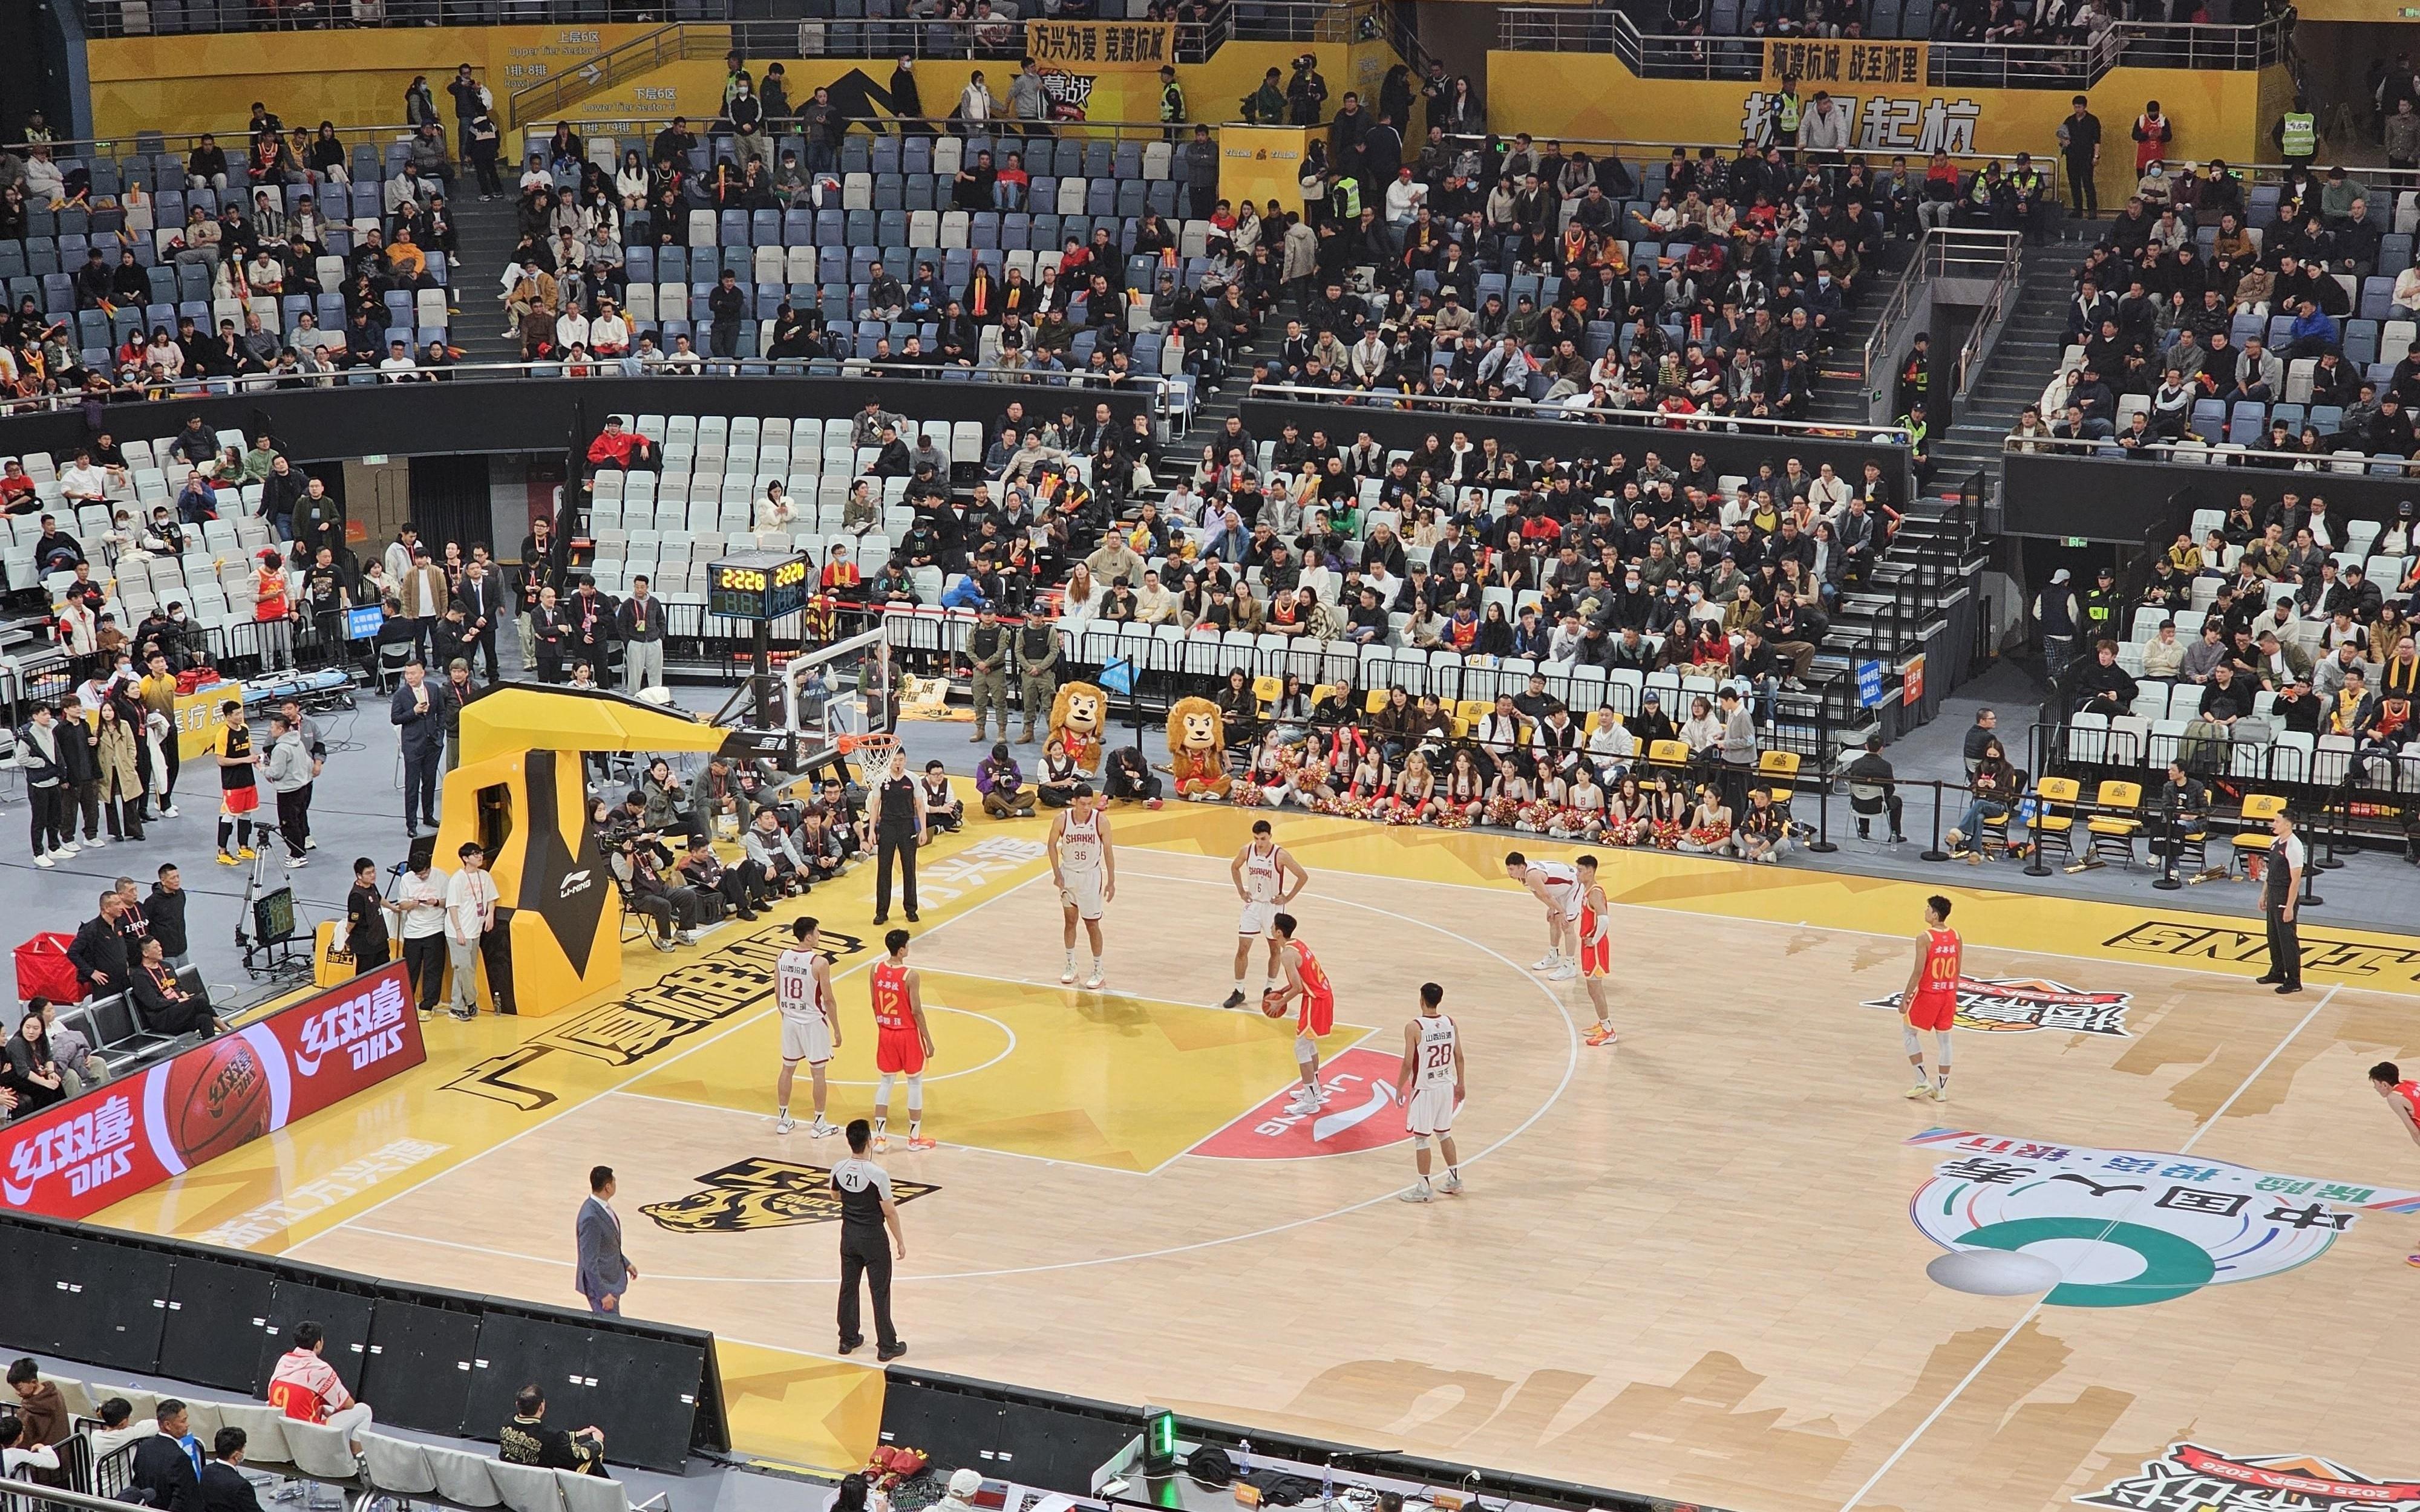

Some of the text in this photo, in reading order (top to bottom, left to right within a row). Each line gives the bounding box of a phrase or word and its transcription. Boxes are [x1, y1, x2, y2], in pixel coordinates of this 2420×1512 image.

[558, 31, 600, 43] 上层6区
[1035, 24, 1165, 62] 方兴为爱 竞渡杭城
[508, 47, 538, 56] Upper
[562, 46, 594, 54] Sector
[595, 46, 601, 55] 6
[504, 64, 547, 76] 1排-8排
[1771, 42, 1918, 83] 狮渡杭城 战至浙里
[633, 88, 676, 100] 下层6区
[1042, 74, 1091, 108] 幕战
[583, 103, 675, 112] Lower Tier Sector 6
[1907, 668, 1922, 688] 卫生间
[1065, 833, 1095, 845] SHANXI
[1074, 851, 1087, 860] 35
[1249, 866, 1272, 879] SHANXI
[560, 879, 591, 898] LI-NING
[1257, 883, 1262, 893] 6
[327, 952, 353, 965] 浙江
[2102, 922, 2420, 981] INS
[780, 964, 807, 976] 山西汾酒
[1311, 960, 1324, 984] 2
[1932, 956, 1956, 980] 00
[784, 977, 803, 999] 18
[1998, 988, 2052, 1000] CBA
[878, 990, 898, 1015] 12
[2052, 995, 2095, 1003] 2025
[298, 978, 405, 1066] 红双喜
[436, 924, 866, 1111] 广厦雄狮
[1955, 992, 2119, 1031] 揭幕
[1425, 1031, 1451, 1042] 山西汾酒
[1427, 1043, 1452, 1069] 28
[1254, 1074, 1364, 1137] LI-NG
[7, 1095, 134, 1196] 红双喜
[845, 1173, 858, 1188] 21
[1941, 1158, 2355, 1231] 中国人寿
[273, 1386, 290, 1410] 9
[2199, 1461, 2391, 1499] 2025 CBA 2026
